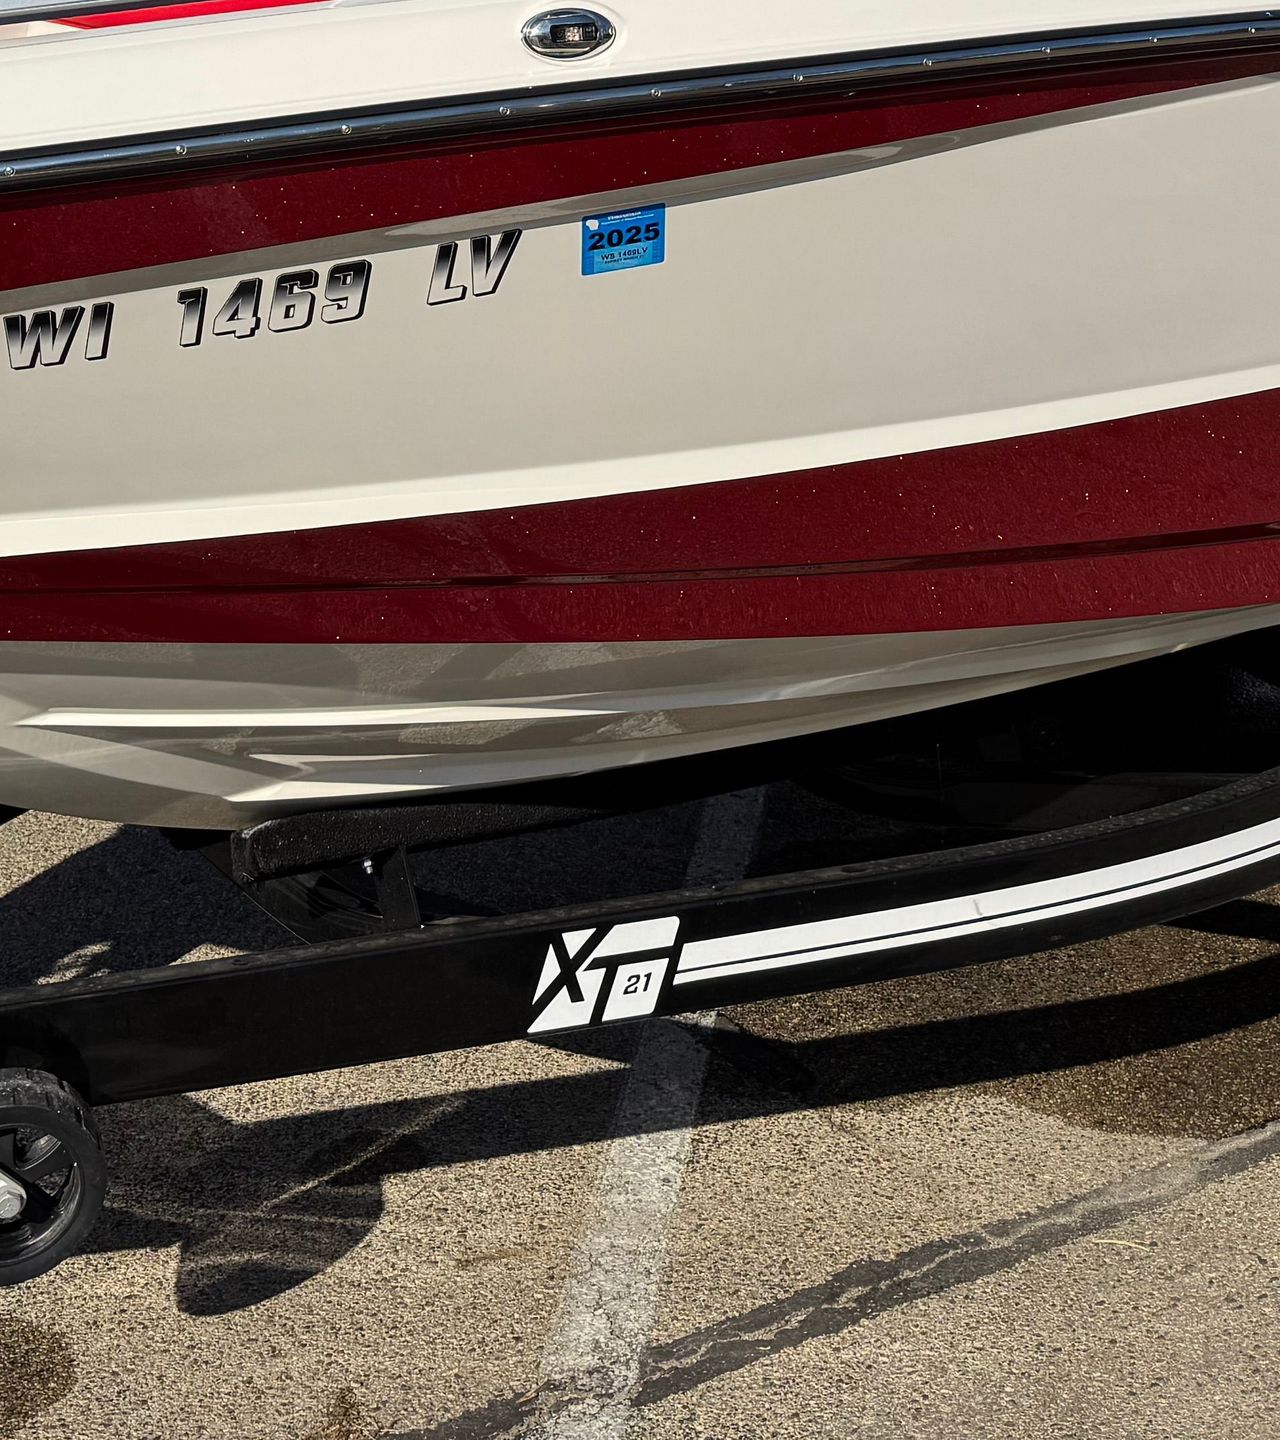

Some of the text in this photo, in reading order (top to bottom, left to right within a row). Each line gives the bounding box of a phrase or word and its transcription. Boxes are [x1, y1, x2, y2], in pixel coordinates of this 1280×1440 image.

[588, 222, 660, 252] 2025
[3, 228, 522, 371] WI 1469 LV
[527, 921, 673, 1032] XT 21
